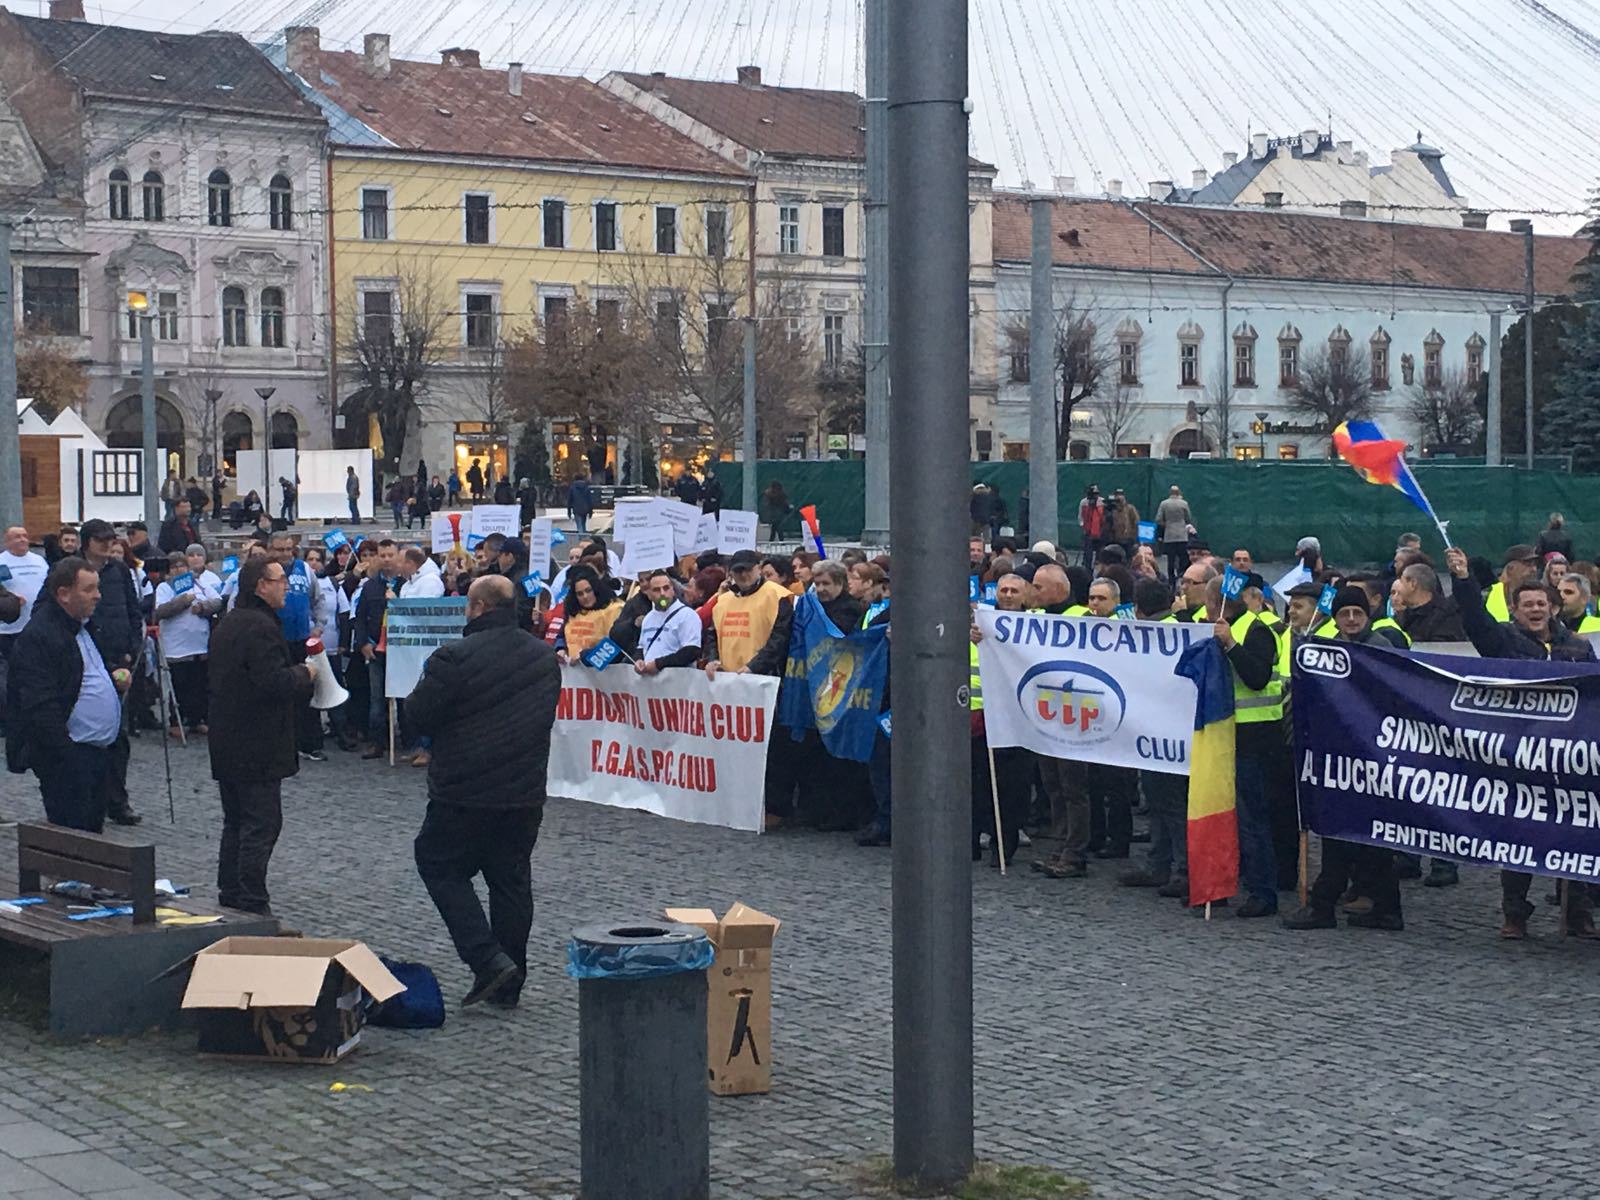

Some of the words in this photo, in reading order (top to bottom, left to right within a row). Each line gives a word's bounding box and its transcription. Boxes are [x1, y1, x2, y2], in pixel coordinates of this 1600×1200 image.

[590, 641, 616, 669] BNS
[1302, 648, 1346, 673] BNS
[556, 687, 645, 730] NDICATUL
[709, 703, 765, 742] CLUJ
[1457, 684, 1575, 714] PUBLISIND
[1135, 734, 1185, 763] CLUJ
[1376, 715, 1508, 767] SINDICATUL
[1324, 753, 1510, 817] LUCRĂTORILOR
[1513, 782, 1549, 823] DE
[1371, 820, 1538, 867] PENITENCIARUL
